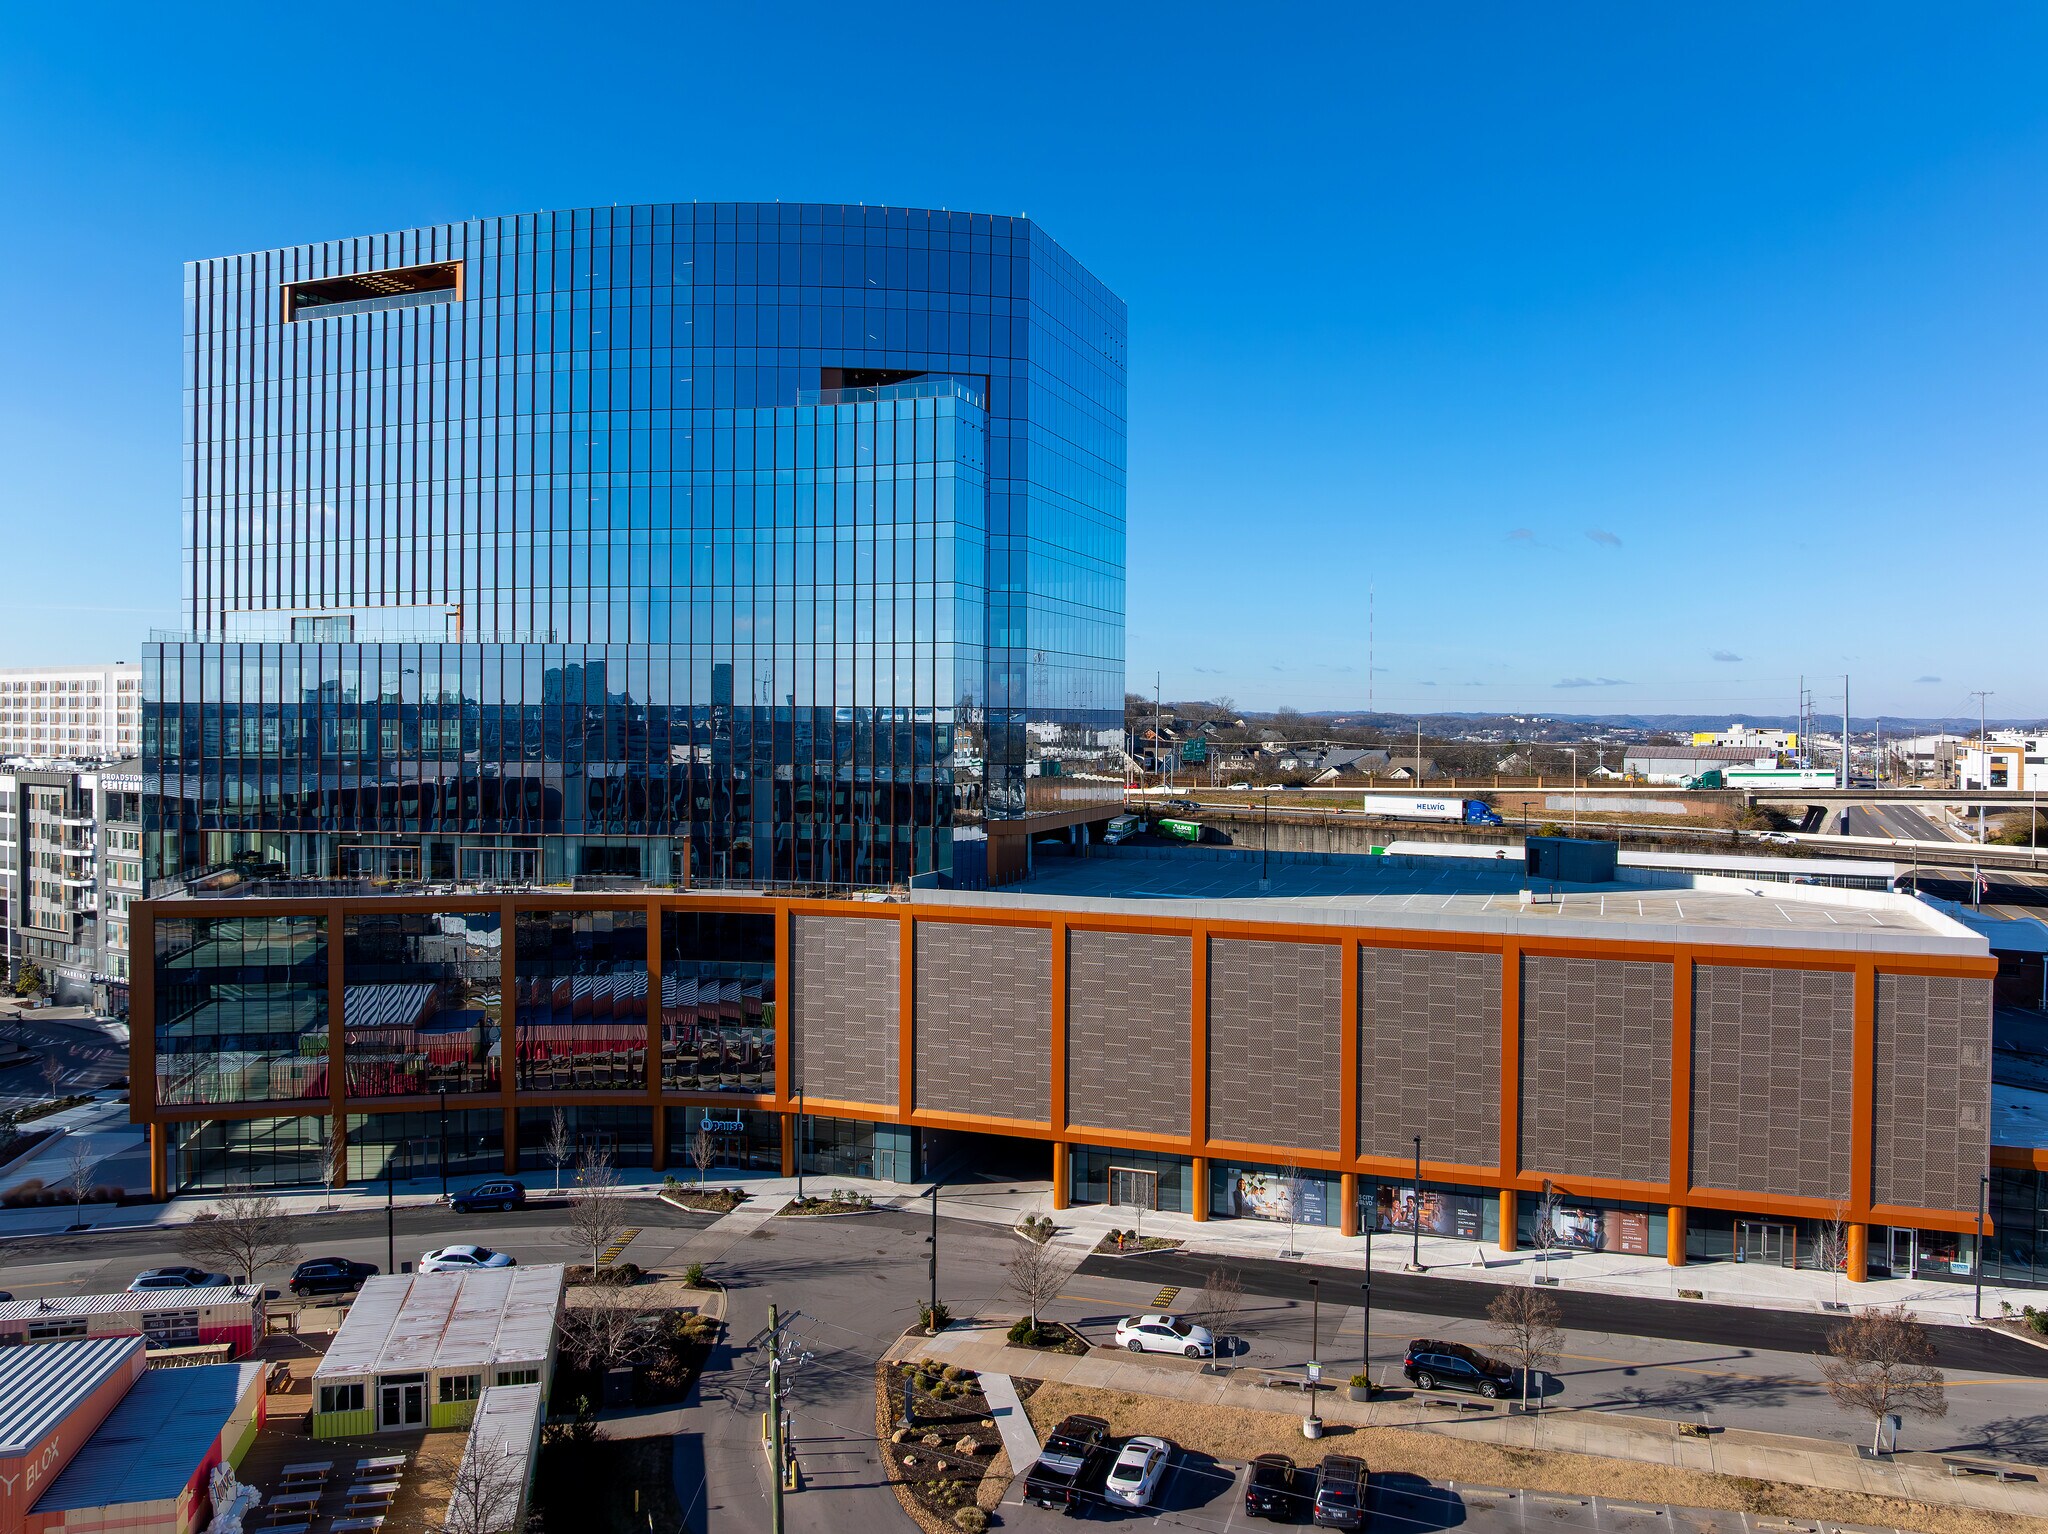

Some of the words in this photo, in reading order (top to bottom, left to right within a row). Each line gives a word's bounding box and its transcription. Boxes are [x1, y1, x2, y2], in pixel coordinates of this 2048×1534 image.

[1416, 803, 1445, 811] HELWIG
[91, 973, 125, 984] EASING
[712, 1120, 744, 1131] pause
[26, 1435, 60, 1492] BLOX
